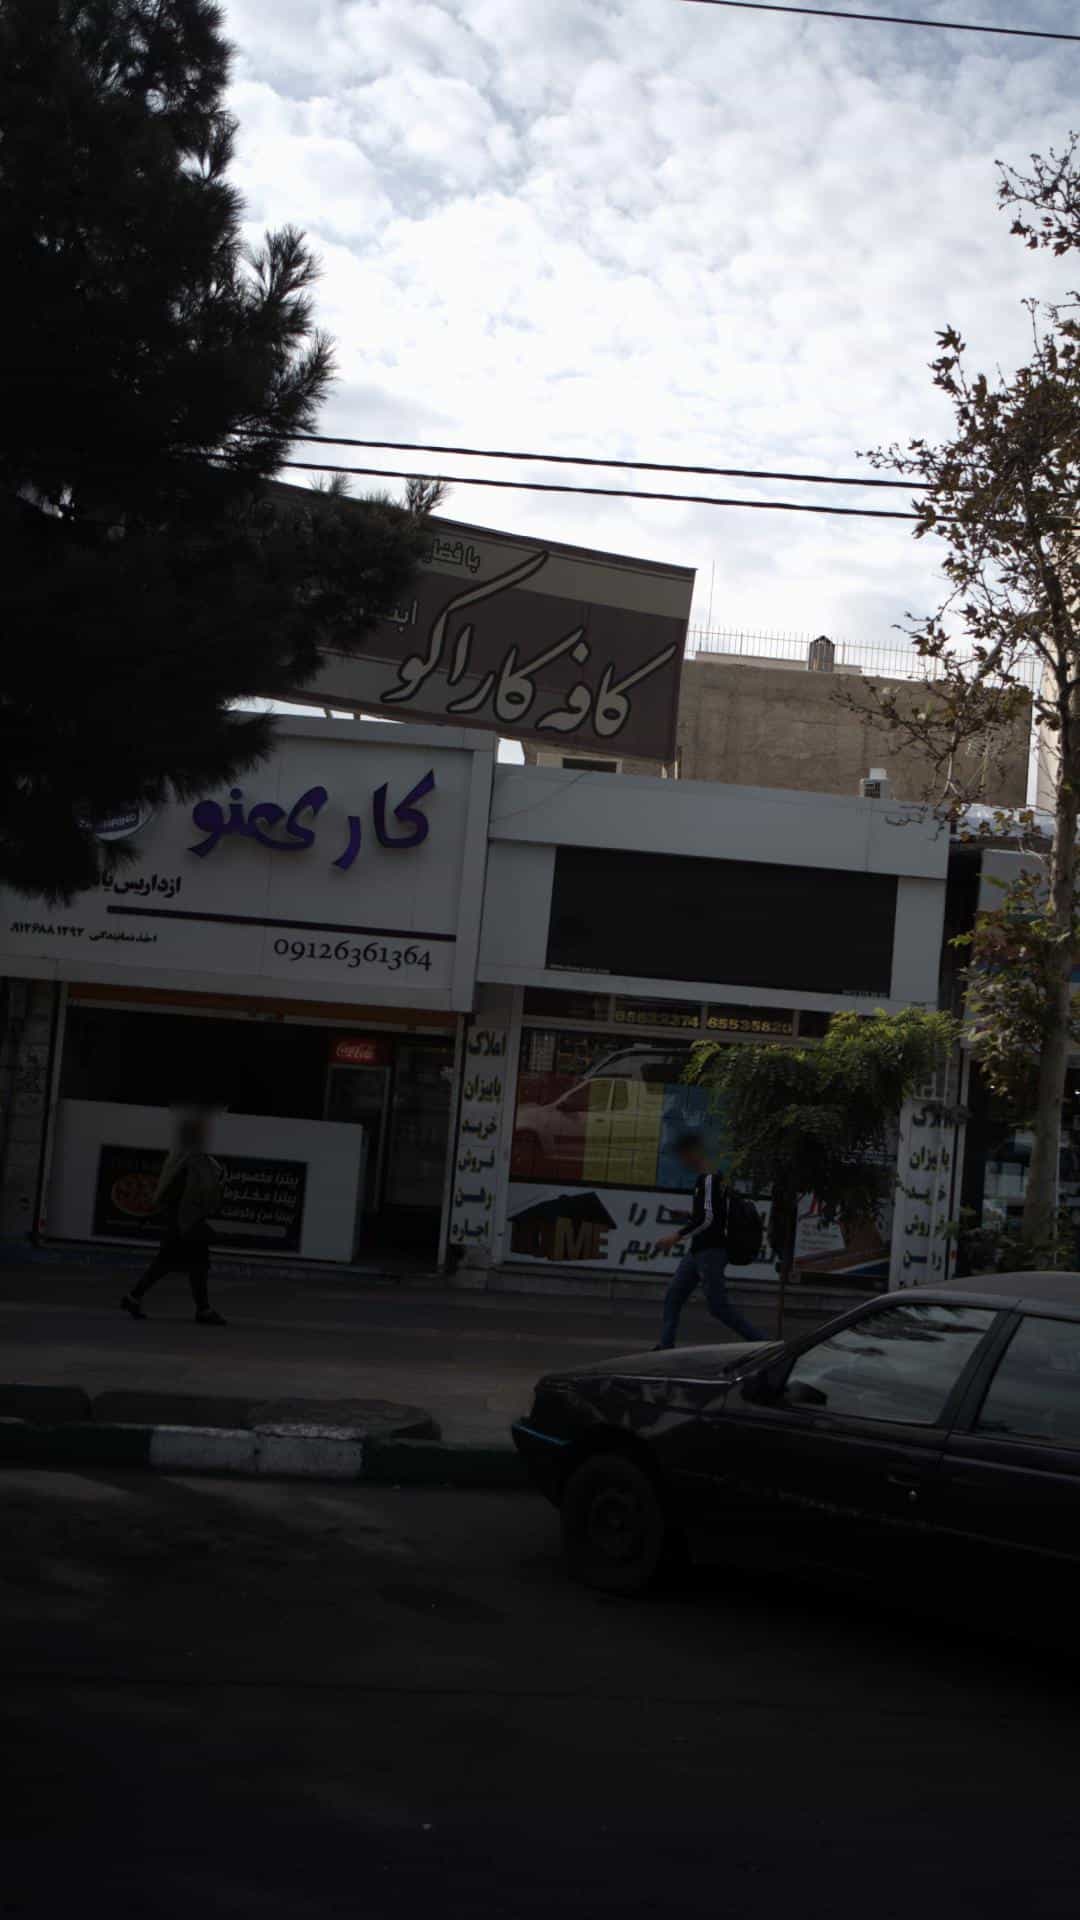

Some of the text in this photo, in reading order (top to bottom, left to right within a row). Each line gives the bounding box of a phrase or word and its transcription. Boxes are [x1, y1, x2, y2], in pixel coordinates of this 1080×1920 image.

[535, 640, 678, 738] کافه
[274, 937, 432, 970] 09126361364
[467, 1030, 507, 1057] املاک
[461, 1115, 497, 1141] خرید
[458, 1148, 495, 1172] فروش
[628, 1201, 647, 1227] را
[452, 1218, 488, 1243] اجاره
